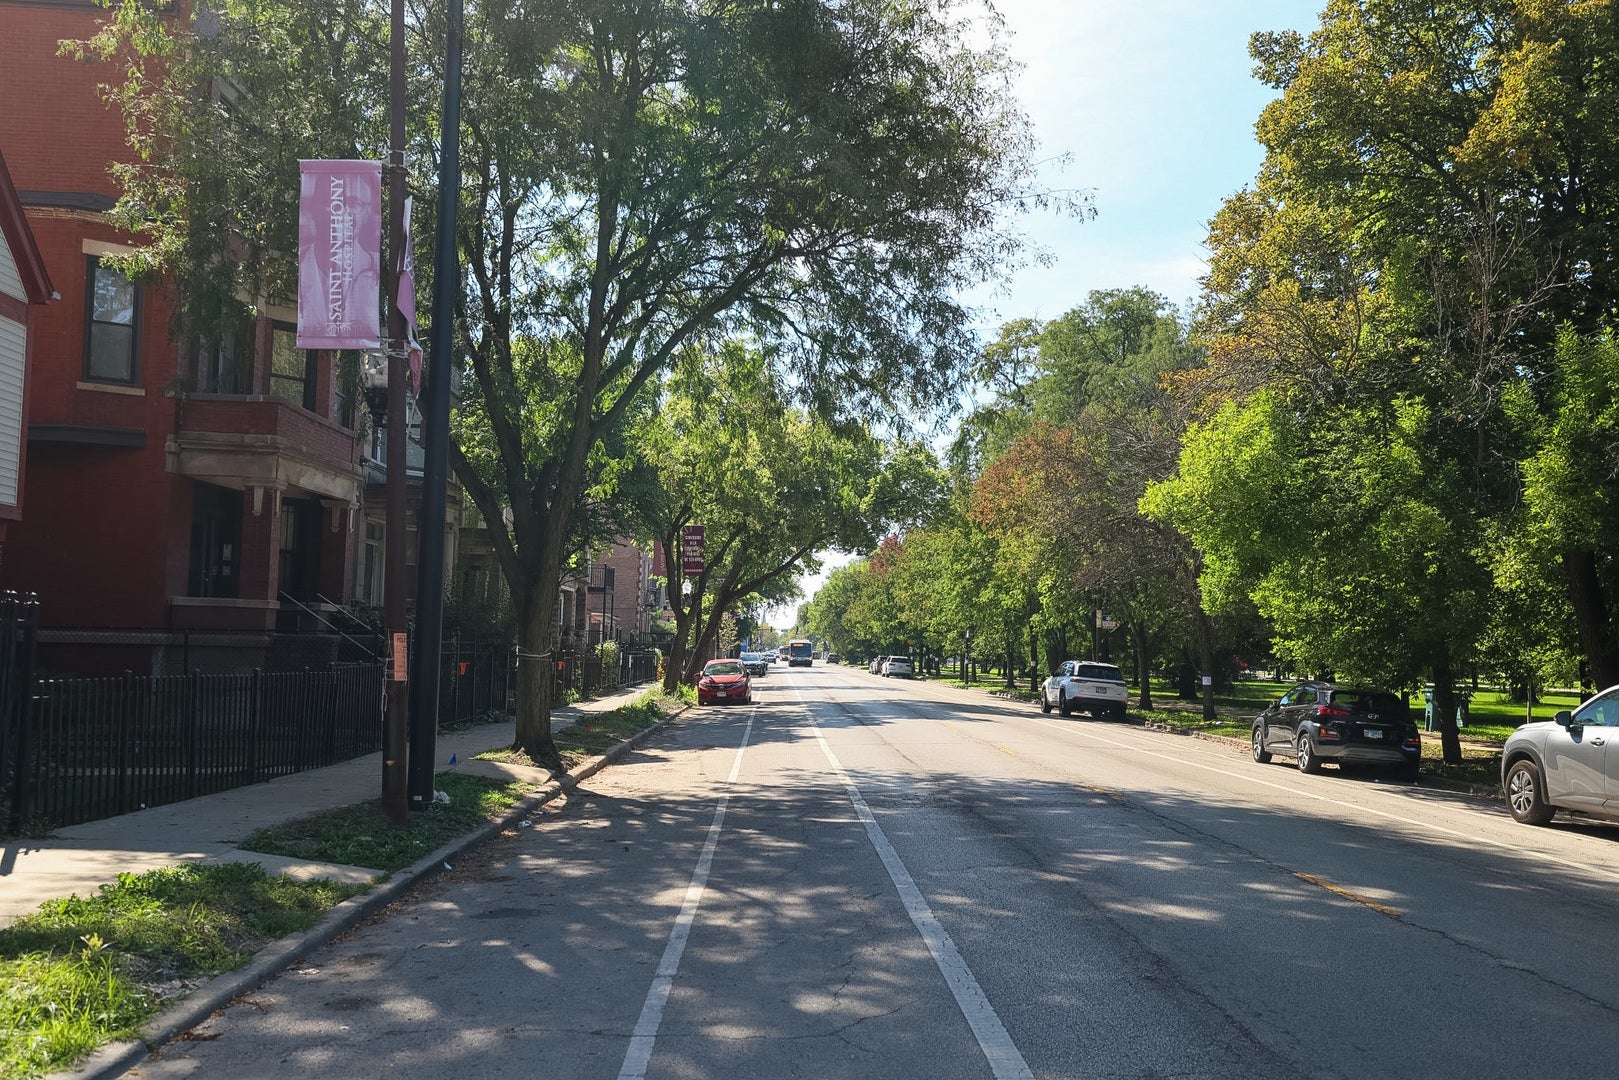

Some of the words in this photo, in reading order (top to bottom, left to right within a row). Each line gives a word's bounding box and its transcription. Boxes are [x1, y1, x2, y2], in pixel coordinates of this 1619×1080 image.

[330, 176, 344, 265] ANTHONY
[343, 213, 353, 281] HOSPITAL
[329, 268, 342, 320] SAINT
